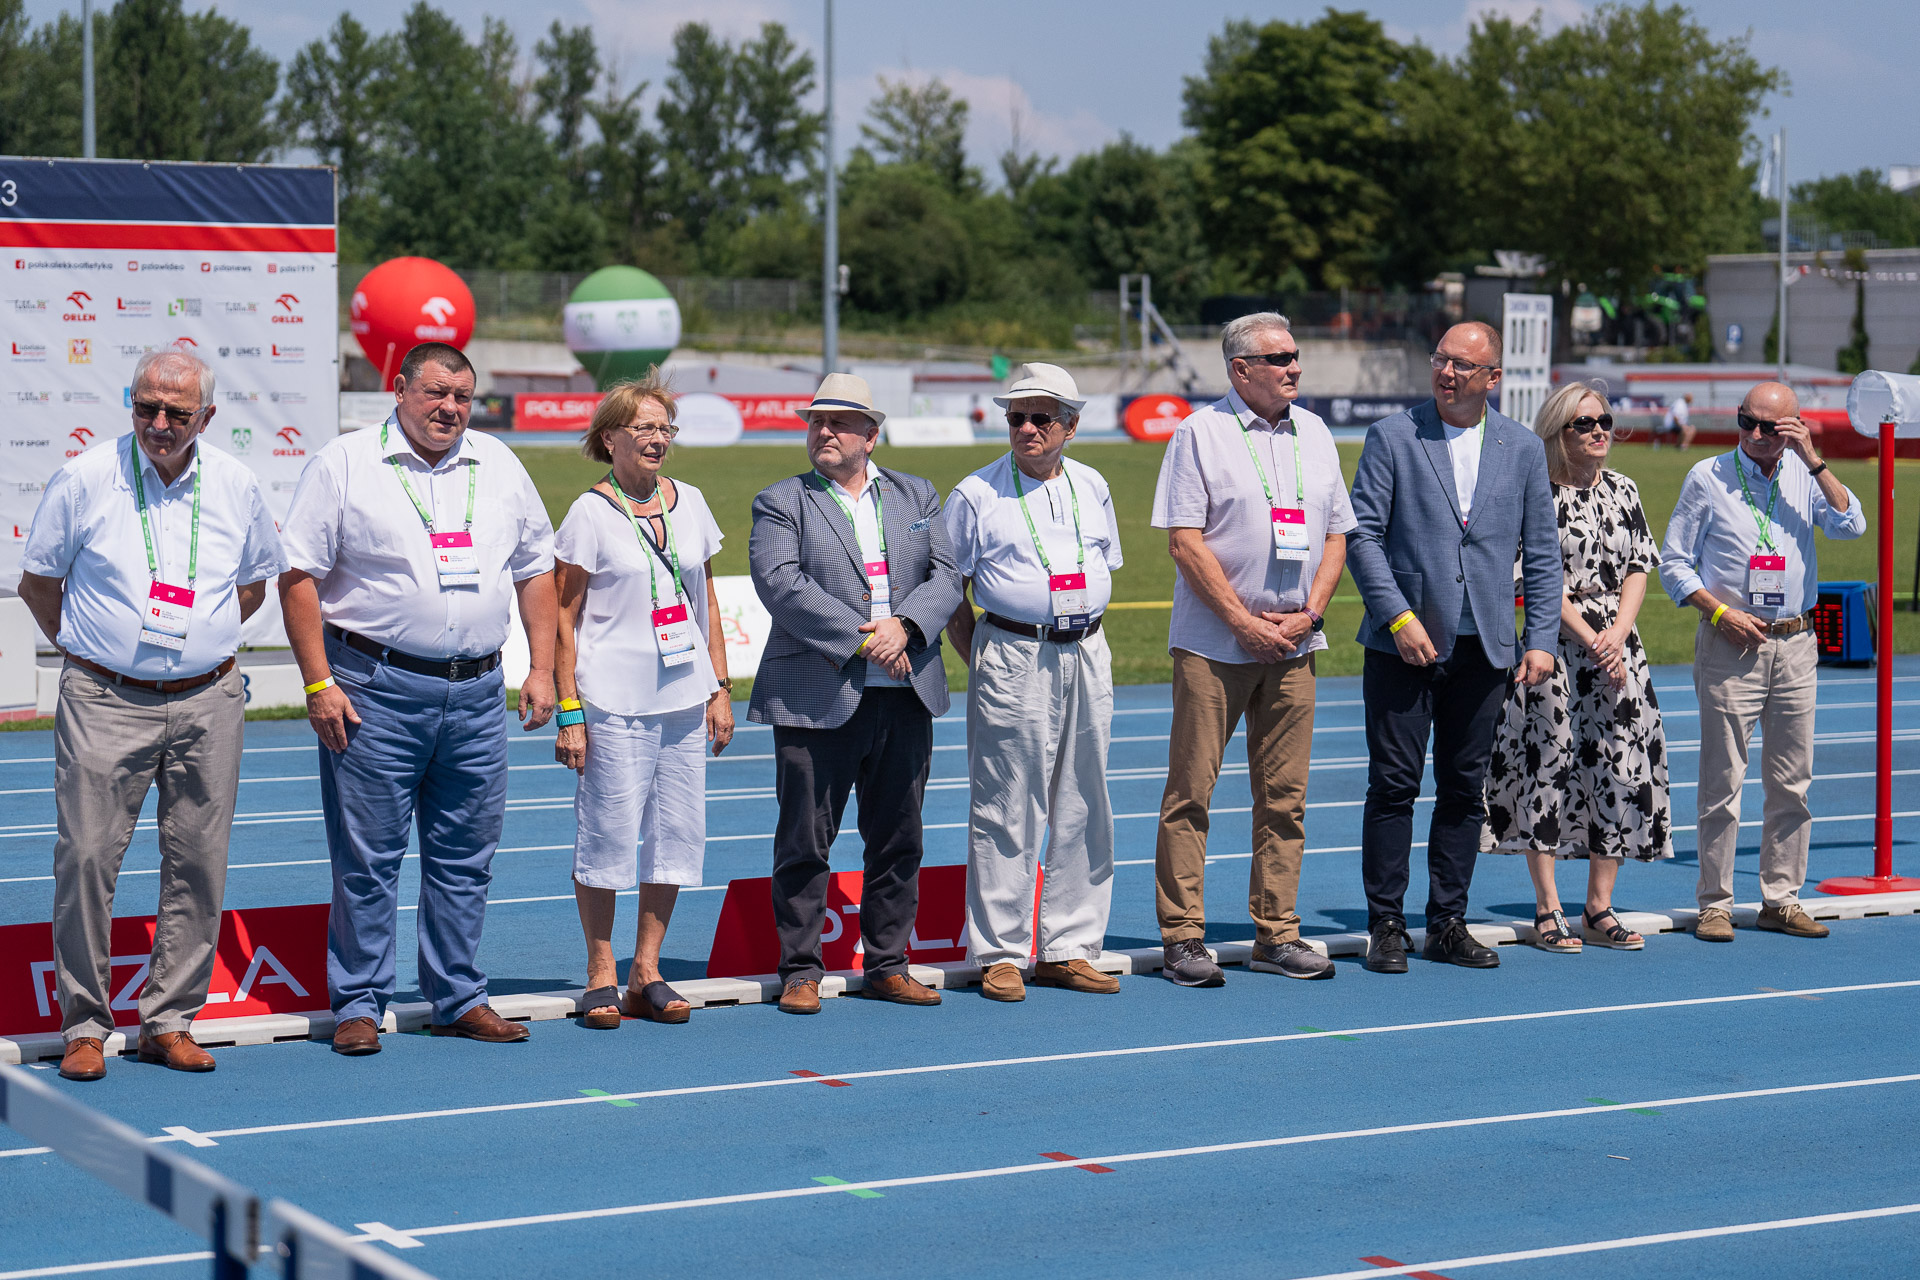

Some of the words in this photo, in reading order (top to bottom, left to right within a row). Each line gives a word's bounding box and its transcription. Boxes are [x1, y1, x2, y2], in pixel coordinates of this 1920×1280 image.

[62, 313, 96, 321] ORLEN
[271, 315, 304, 323] ORLEN
[524, 400, 594, 418] POLSKI
[272, 448, 306, 456] ORLEN
